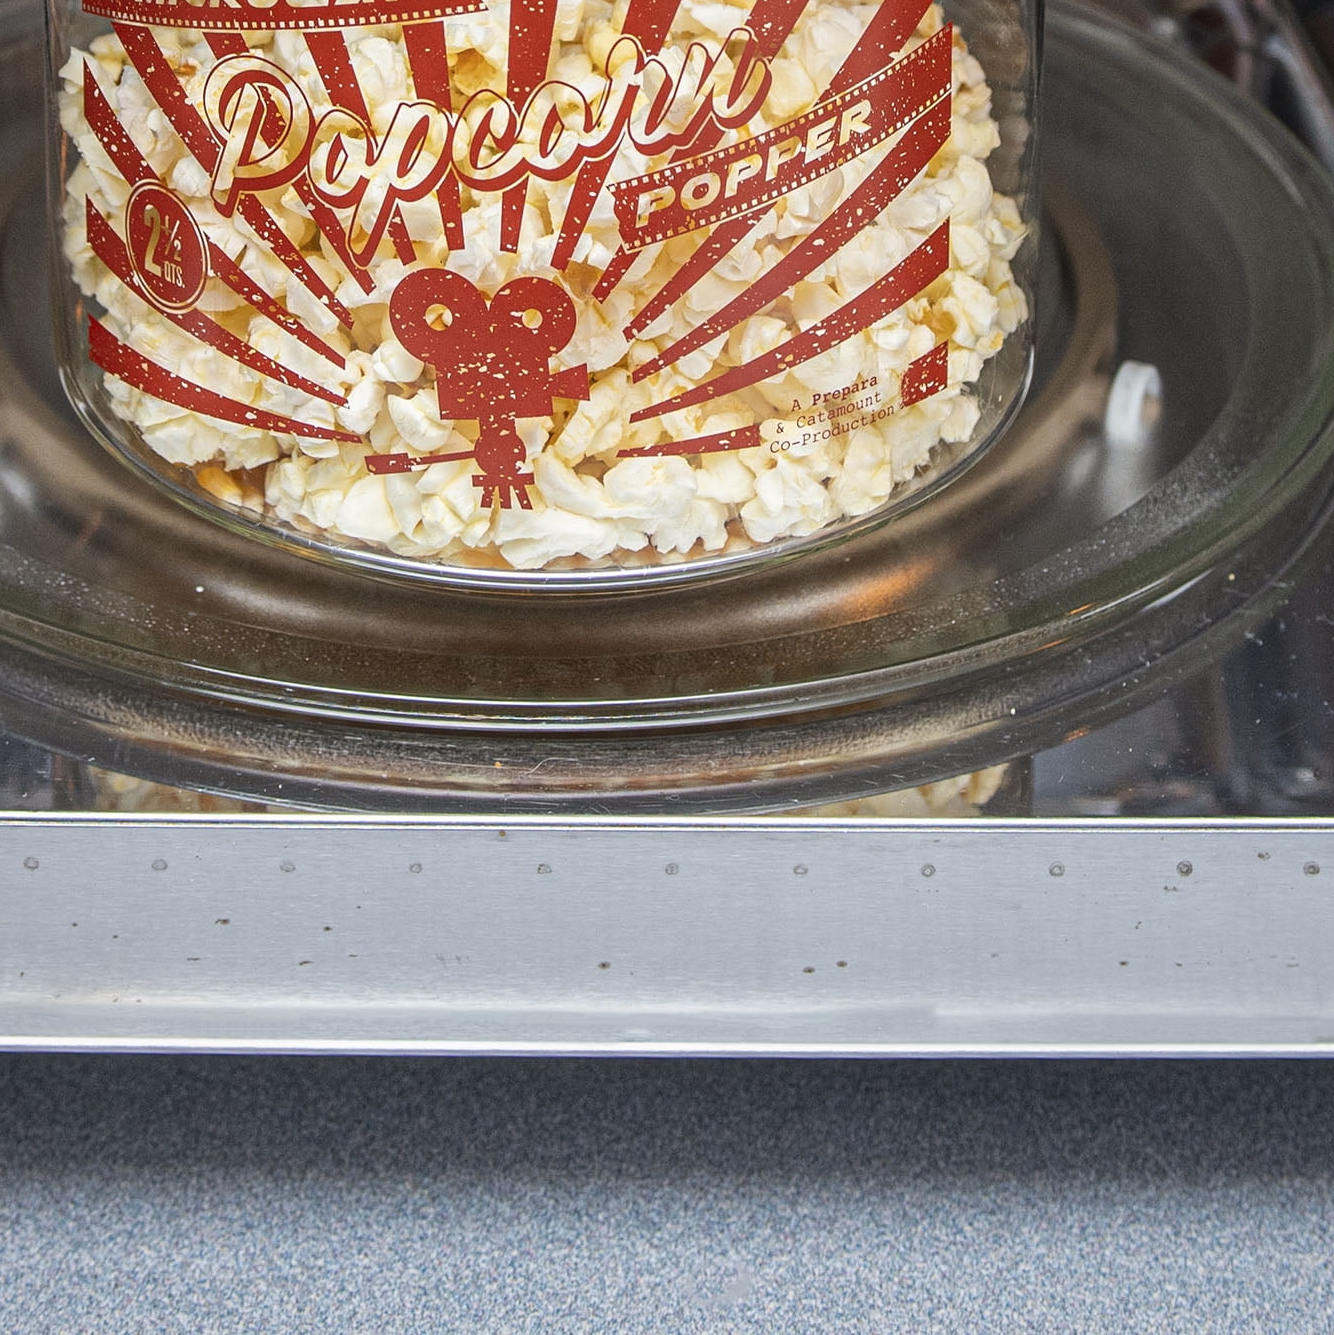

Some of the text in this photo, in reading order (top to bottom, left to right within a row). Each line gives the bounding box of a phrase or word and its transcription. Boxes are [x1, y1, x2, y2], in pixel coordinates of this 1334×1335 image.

[202, 26, 773, 268] Popcorn
[640, 100, 873, 229] POPPER
[776, 392, 882, 434] & Catamount
[791, 376, 878, 411] A Prepara
[769, 404, 895, 454] Co-Production
